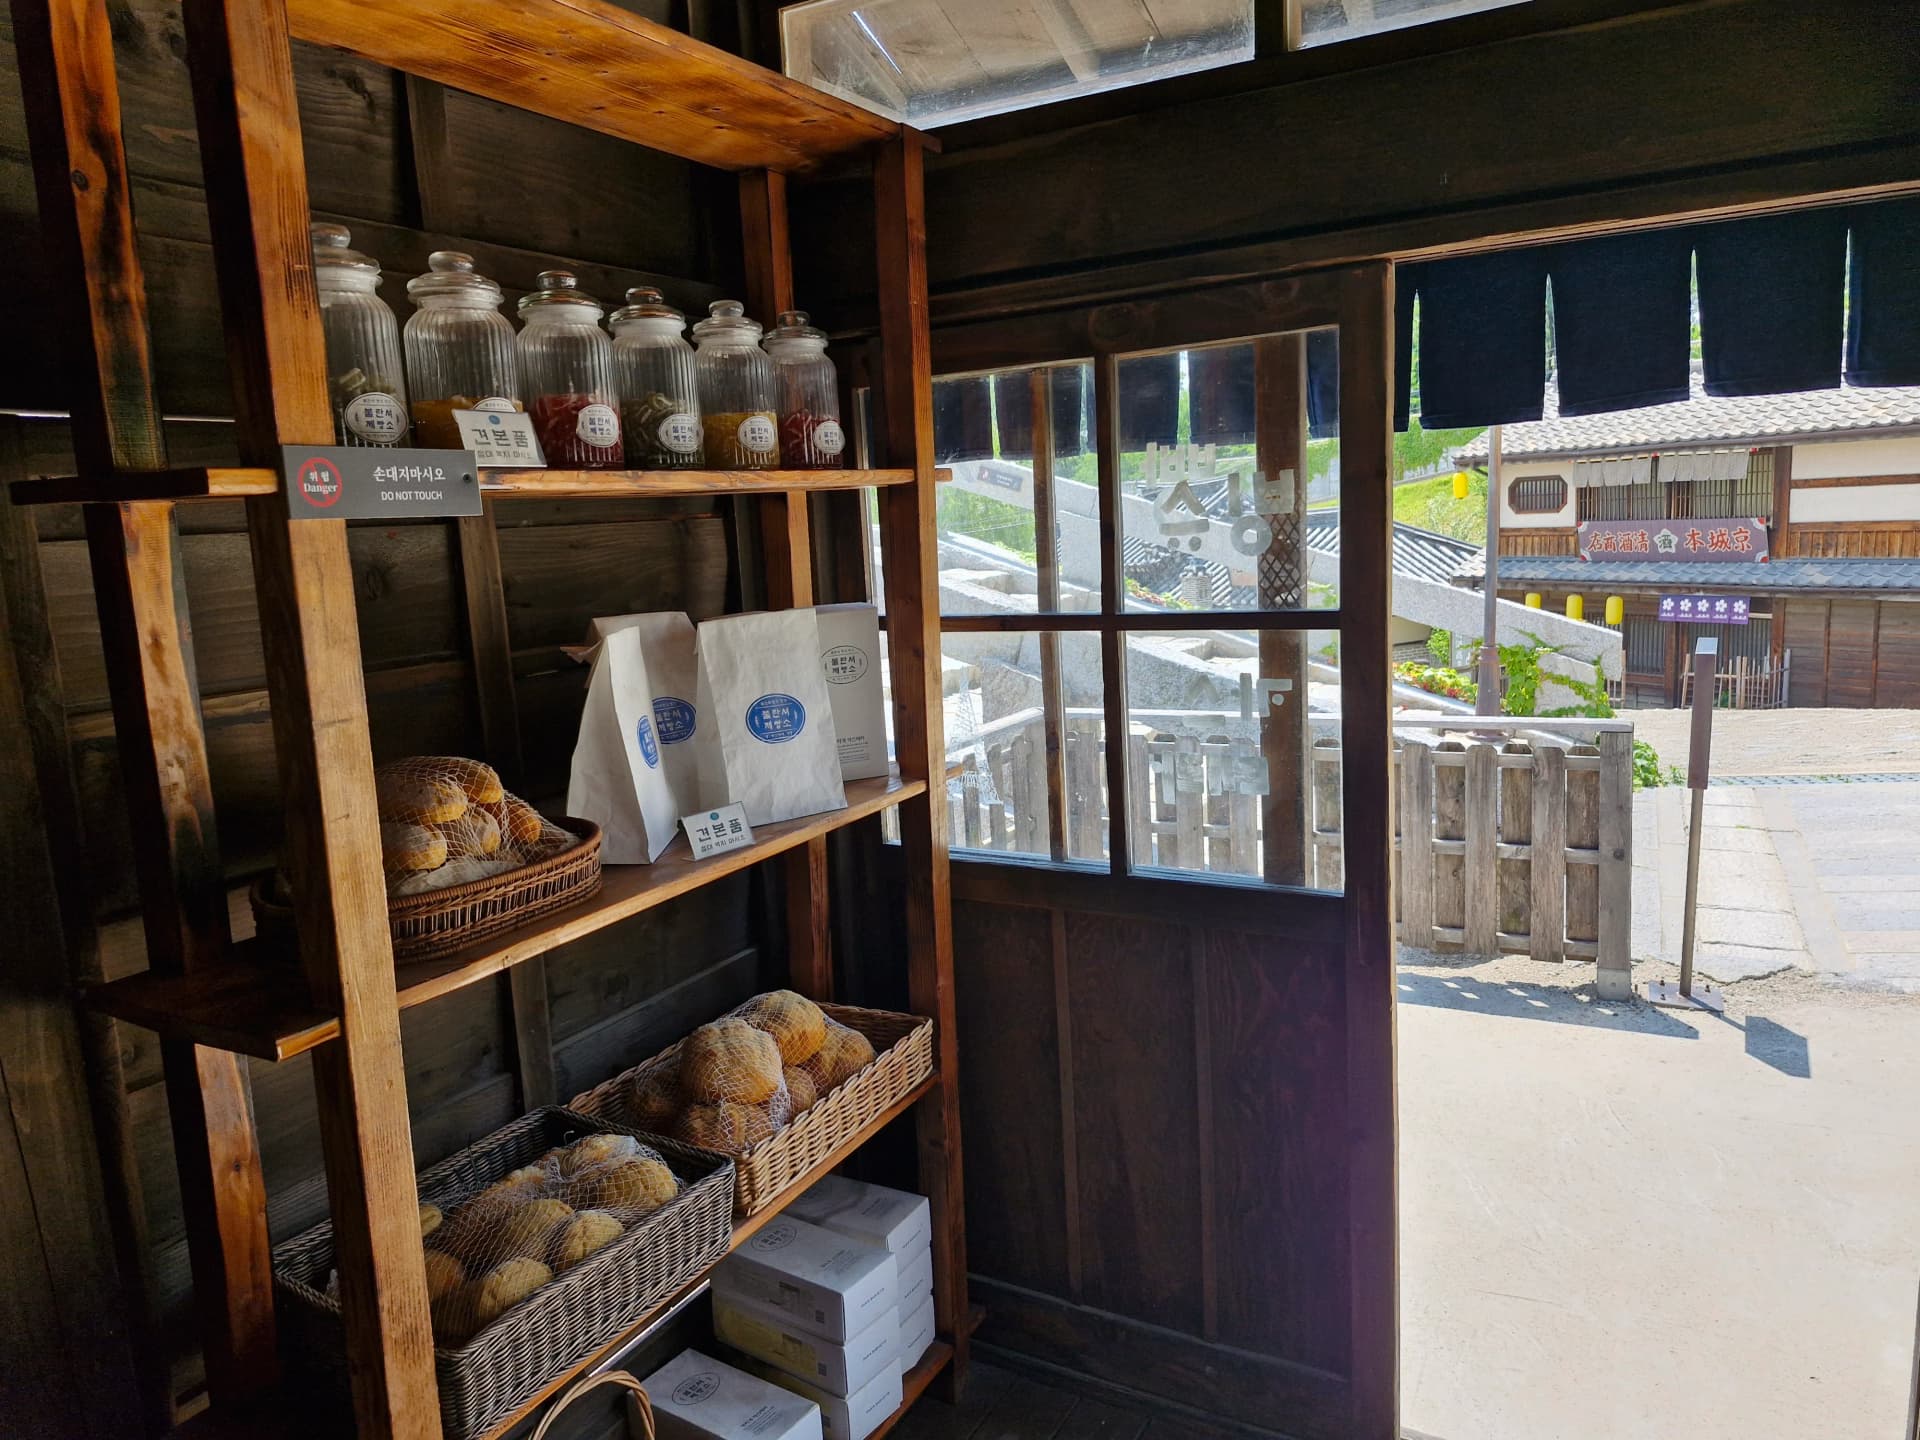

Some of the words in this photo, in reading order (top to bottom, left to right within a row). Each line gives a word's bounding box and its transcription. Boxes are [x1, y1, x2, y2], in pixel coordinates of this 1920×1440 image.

[471, 428, 529, 448] 견본품
[372, 466, 446, 482] 손대지마시오
[303, 482, 338, 495] Danger
[381, 491, 394, 501] DO
[396, 491, 412, 501] NOT
[414, 490, 443, 500] TOUCH
[695, 819, 743, 843] 견본품
